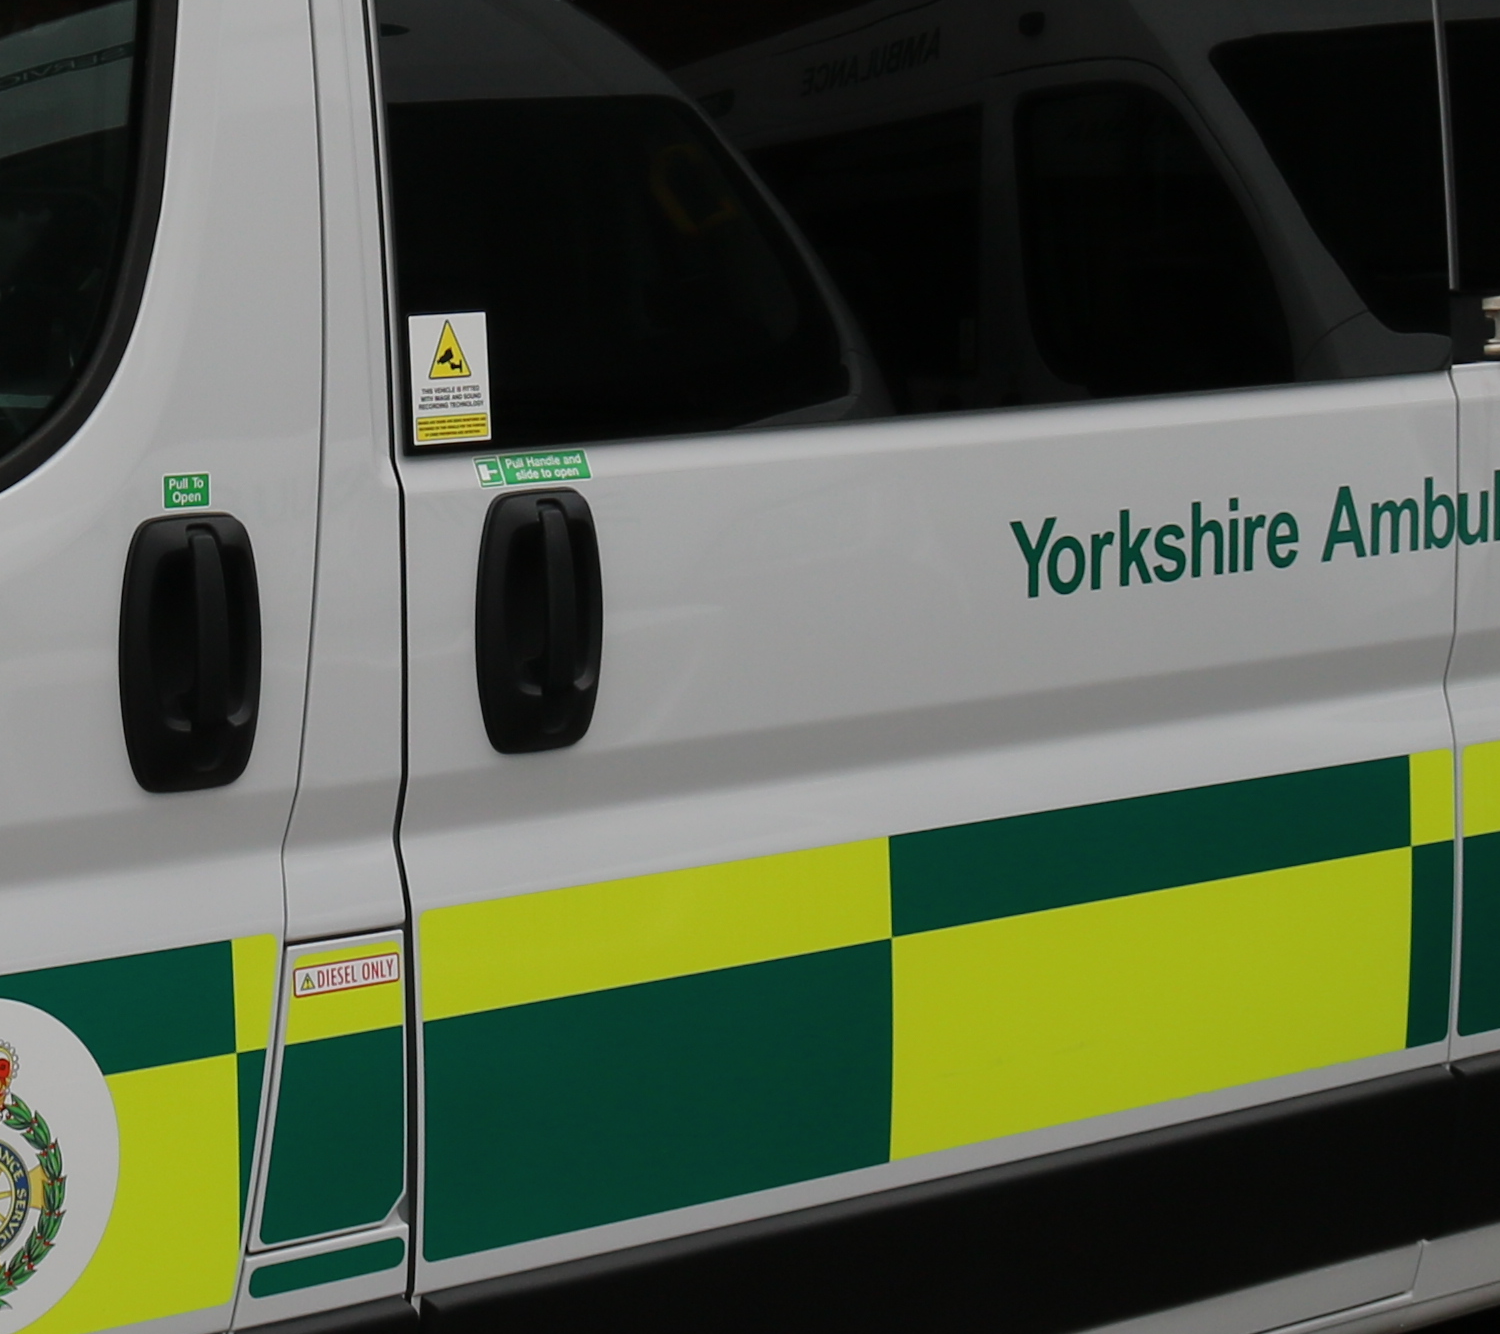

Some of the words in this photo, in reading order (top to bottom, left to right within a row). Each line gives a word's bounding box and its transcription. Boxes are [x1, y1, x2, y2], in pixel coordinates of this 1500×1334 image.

[505, 458, 524, 469] Pull
[527, 455, 560, 467] Handle
[563, 453, 581, 465] and
[515, 469, 539, 481] slide
[541, 468, 552, 479] to
[554, 467, 579, 479] open
[169, 478, 188, 490] Pull
[192, 477, 204, 488] To
[172, 491, 201, 505] Open
[1010, 497, 1299, 599] Yorkshire
[317, 965, 357, 988] DIESEL
[362, 959, 394, 981] ONLY
